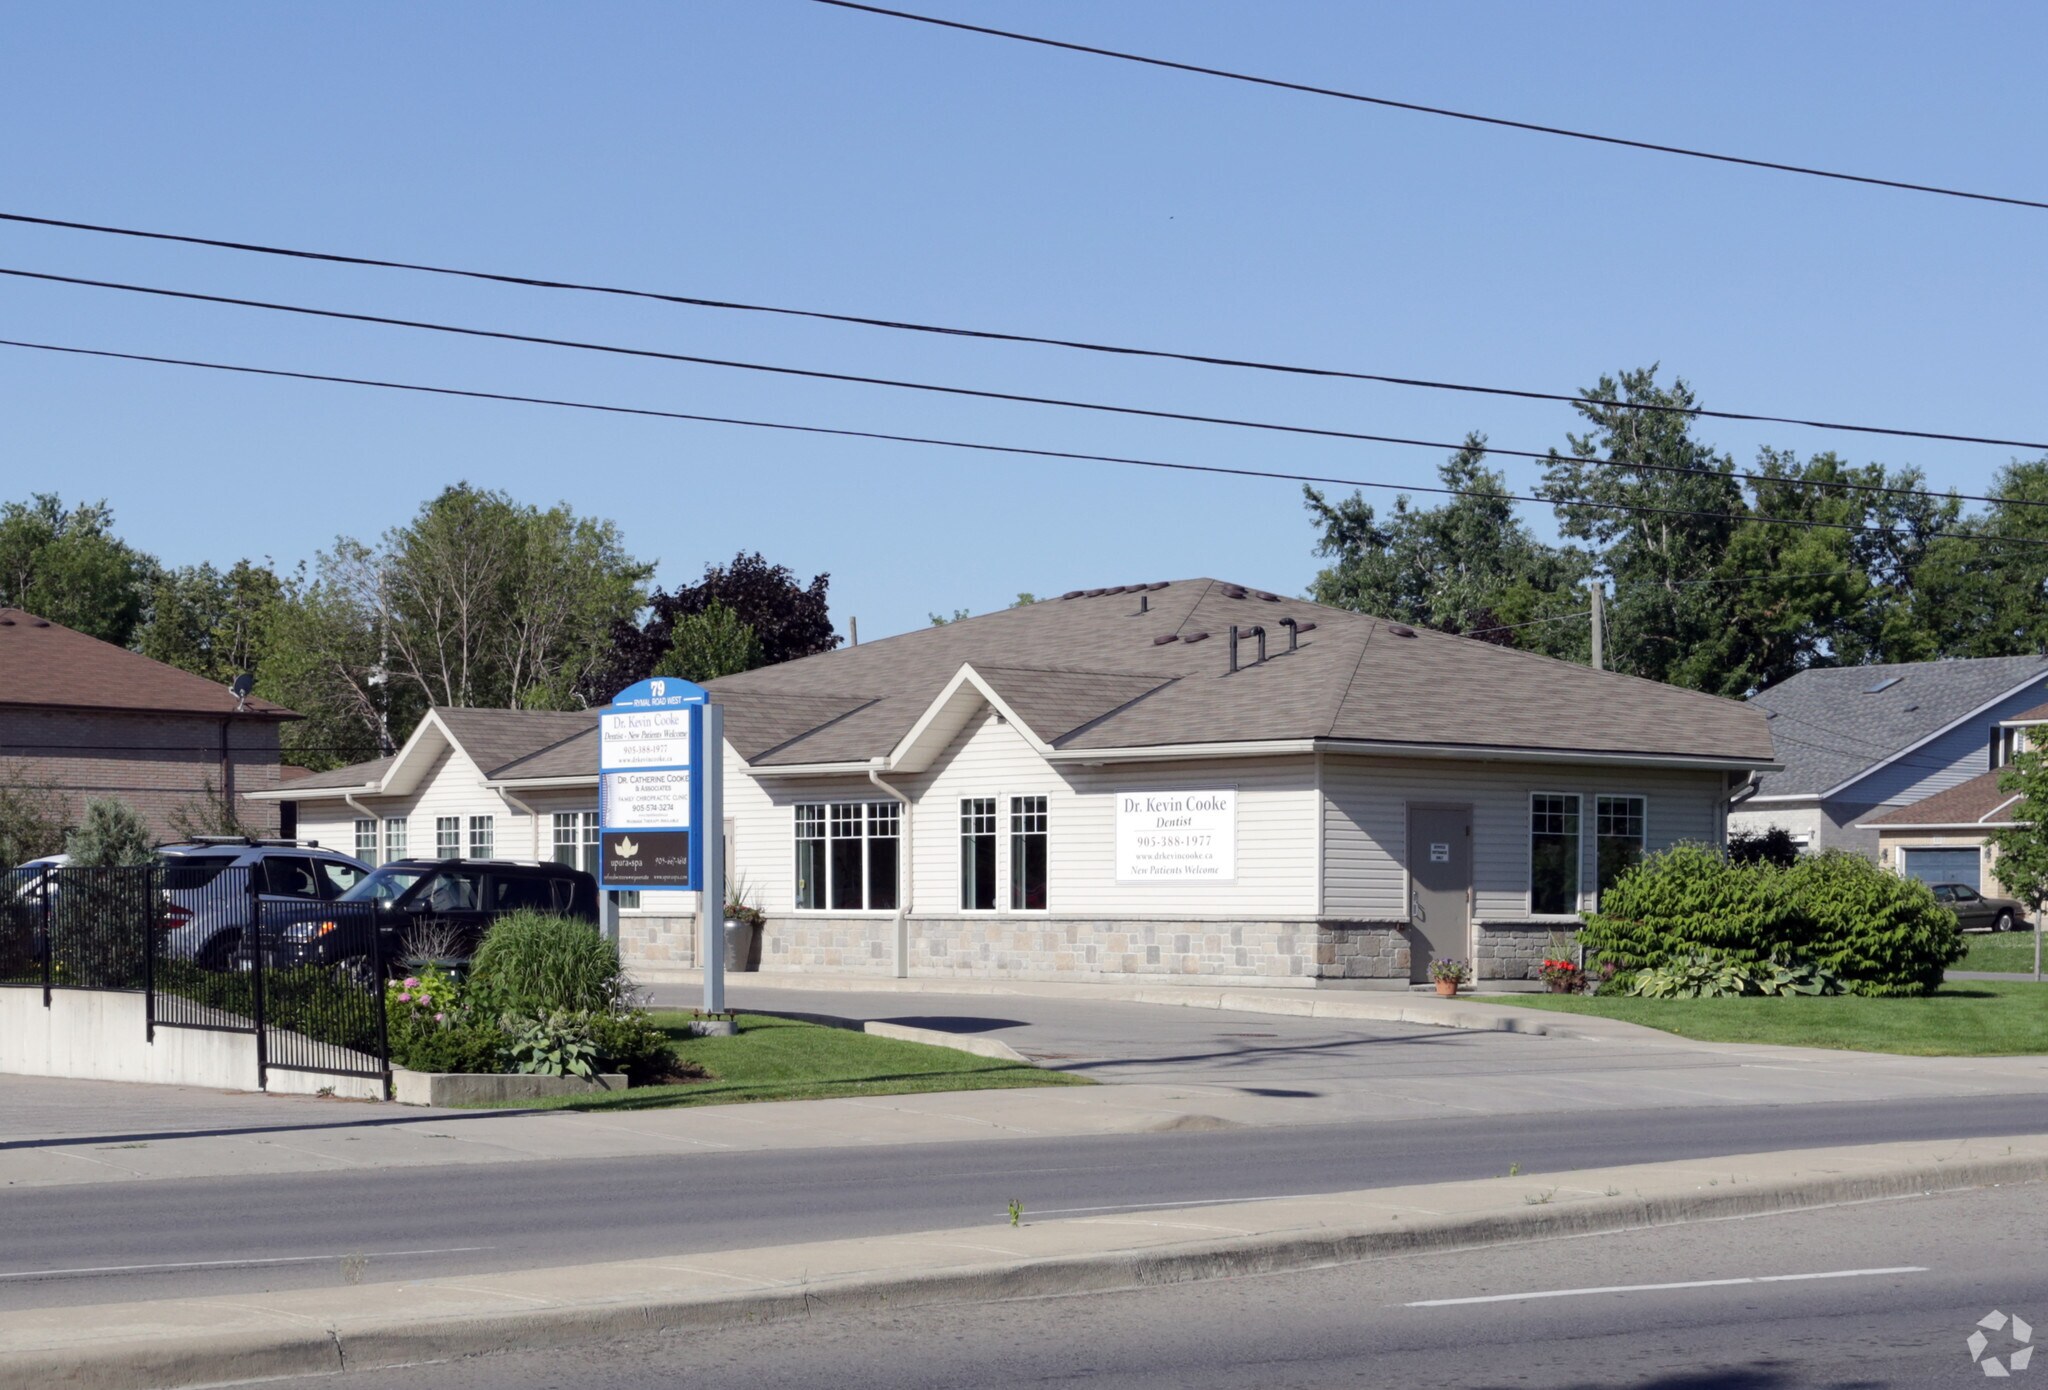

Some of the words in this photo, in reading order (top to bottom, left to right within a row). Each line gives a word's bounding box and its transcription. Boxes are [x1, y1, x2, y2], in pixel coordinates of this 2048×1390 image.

[650, 680, 665, 697] 79
[652, 697, 666, 705] ROAD
[667, 696, 682, 704] WEST
[613, 716, 626, 729] Dr.
[628, 715, 651, 728] Kevin
[654, 713, 680, 726] Cooke
[604, 731, 623, 740] Dentist
[628, 731, 640, 739] New
[641, 730, 662, 739] Patients
[663, 729, 688, 738] Welcome
[623, 744, 668, 755] 905-388-1977
[617, 776, 628, 784] DR.
[629, 774, 666, 784] CATHERINE
[666, 774, 690, 783] COOKE
[1124, 797, 1142, 813] Dr.
[1146, 797, 1182, 813] Kevin
[1186, 795, 1227, 811] Cooke
[1156, 816, 1192, 828] Dentist
[1137, 835, 1212, 847] 905-388-1977
[1135, 851, 1213, 860] www.drkevincooke.ca
[1131, 866, 1148, 875] New
[1149, 865, 1182, 875] Patients
[1184, 865, 1219, 874] Welcome
